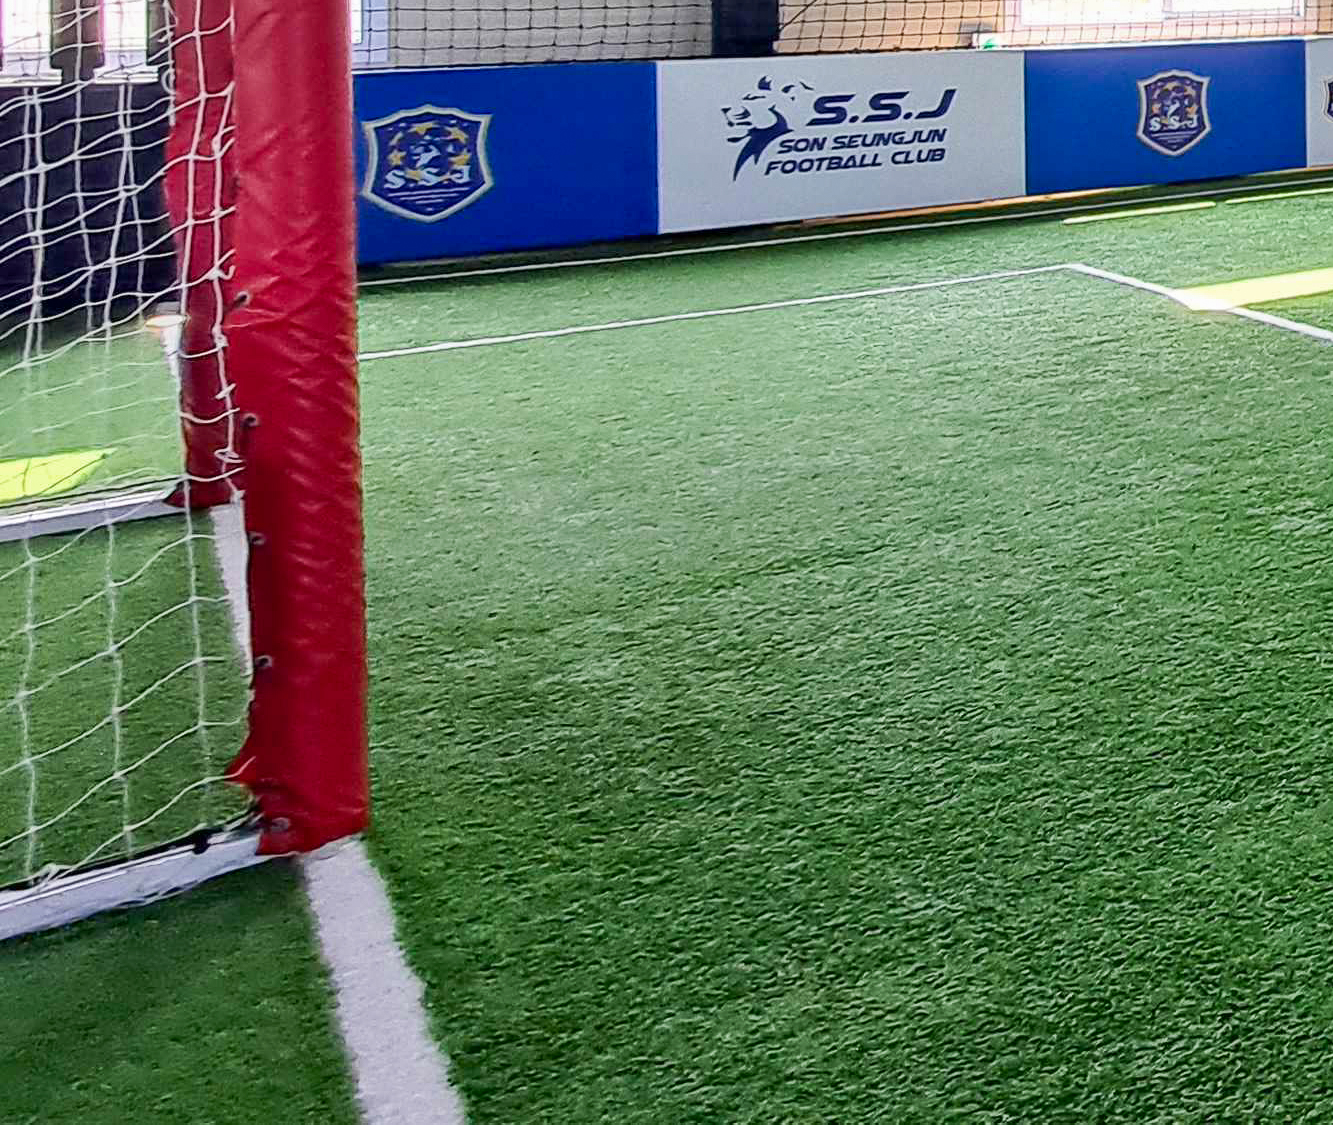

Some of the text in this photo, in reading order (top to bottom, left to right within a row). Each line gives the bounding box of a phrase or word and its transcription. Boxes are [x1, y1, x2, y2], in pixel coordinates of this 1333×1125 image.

[805, 88, 958, 127] S.S.J
[777, 127, 948, 155] SON SEUNGJUN
[764, 147, 947, 176] FOOTBALL CLUB
